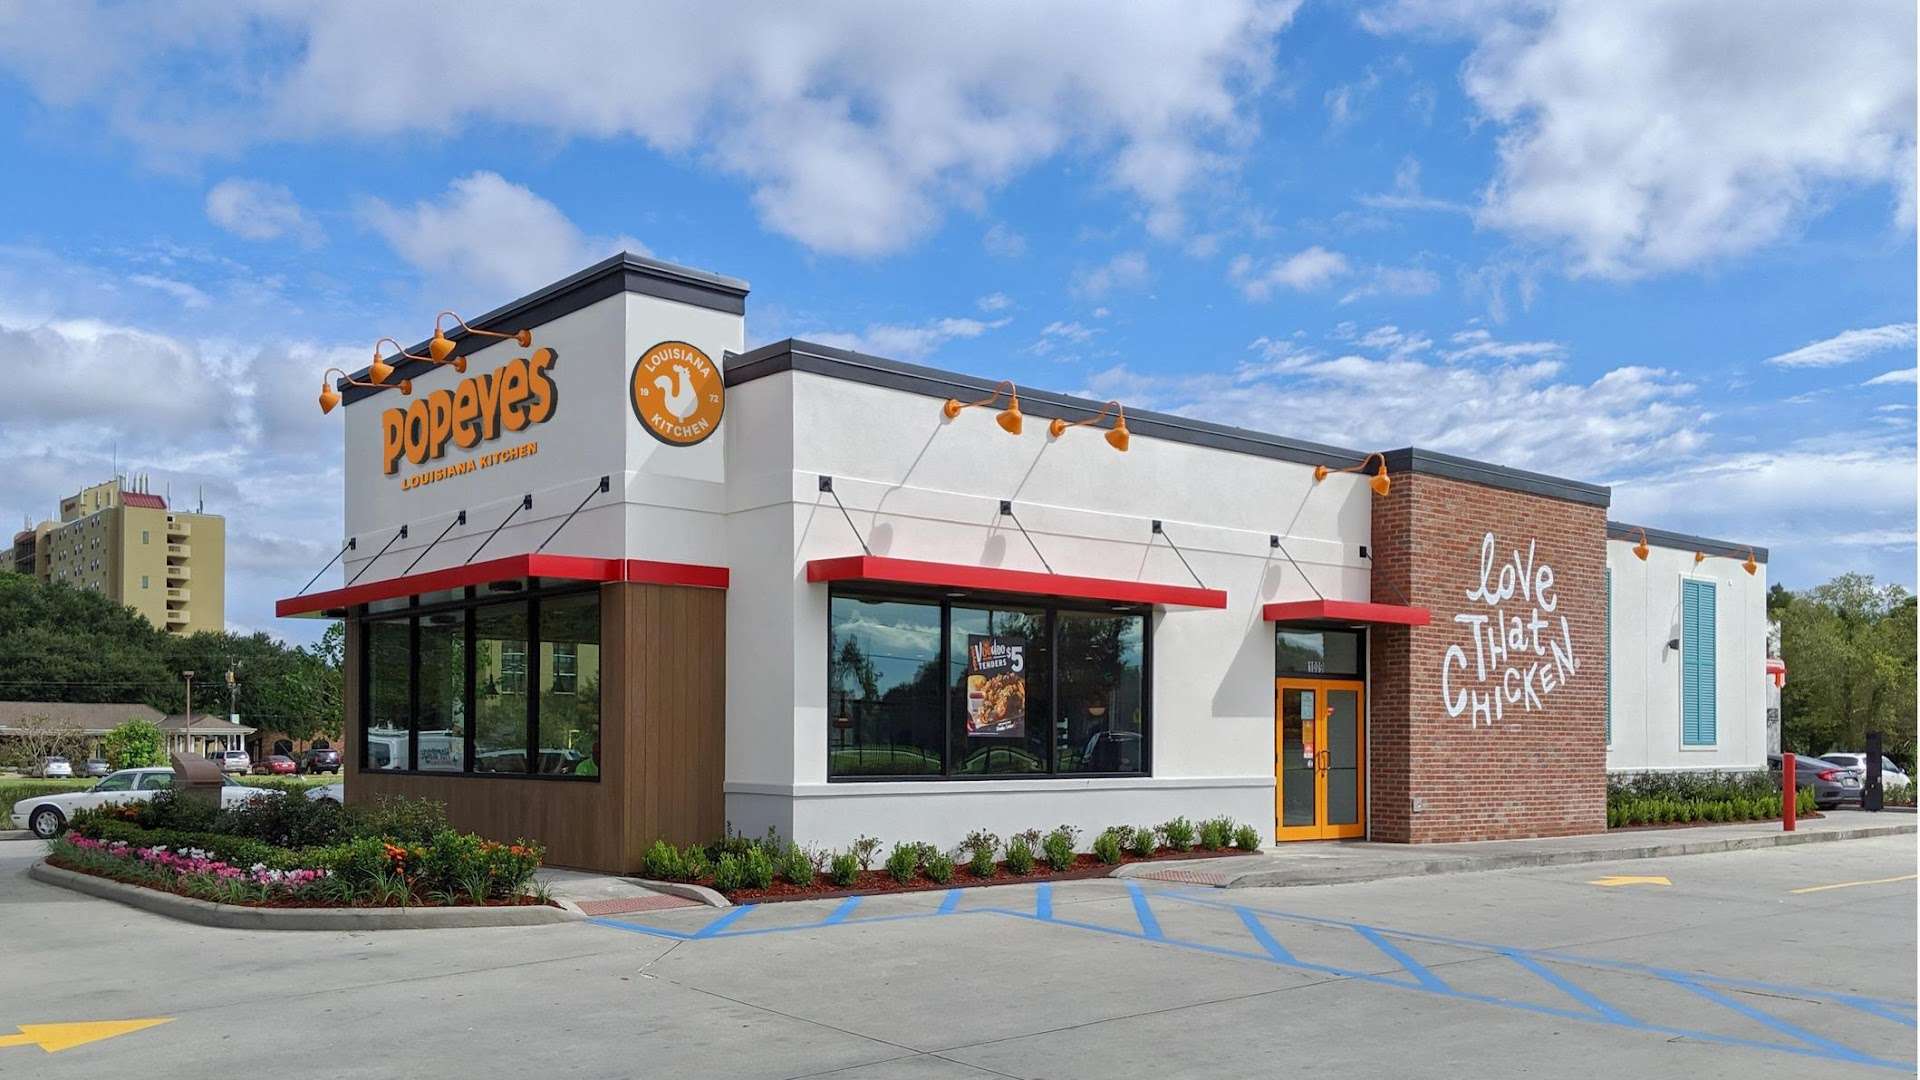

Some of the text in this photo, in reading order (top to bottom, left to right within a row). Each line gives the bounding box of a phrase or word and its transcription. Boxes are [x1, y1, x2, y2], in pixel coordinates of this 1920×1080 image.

[644, 348, 711, 378] LOUISIANA
[640, 387, 650, 397] 19
[651, 412, 709, 437] KITCHEN
[401, 441, 538, 491] LOUISIANA KITCHEN
[979, 658, 1007, 670] TENDERS
